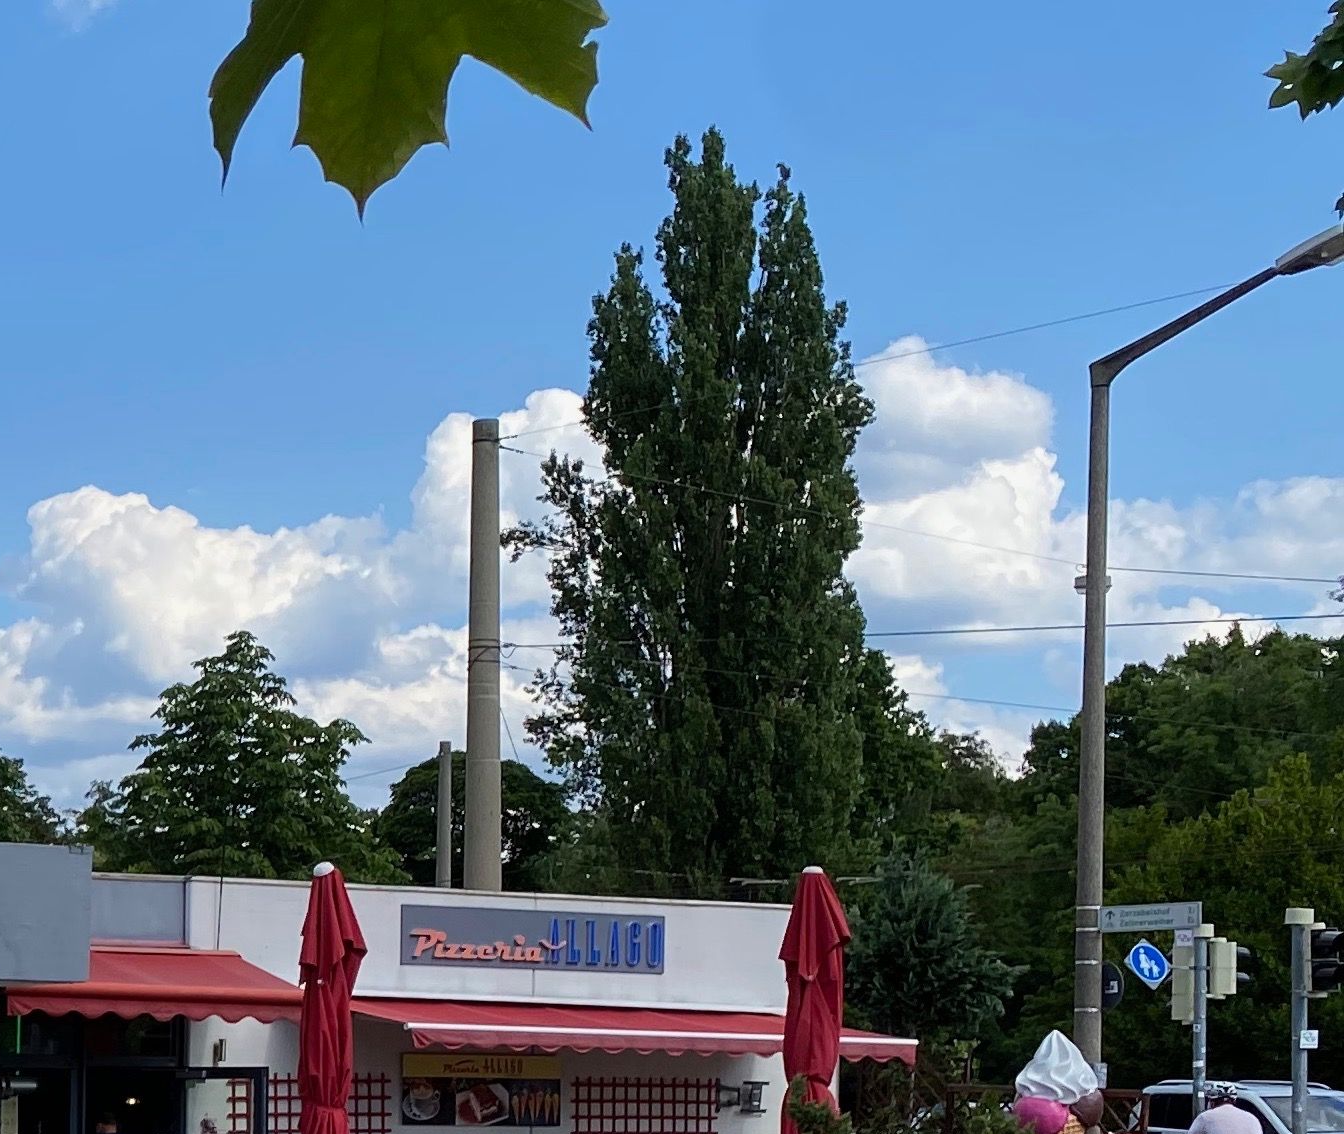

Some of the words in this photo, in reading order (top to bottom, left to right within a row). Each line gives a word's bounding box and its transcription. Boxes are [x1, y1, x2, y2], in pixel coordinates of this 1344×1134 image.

[409, 928, 544, 963] Pizzeria
[543, 916, 663, 967] ALLAGO
[442, 1059, 480, 1073] Pizzeria
